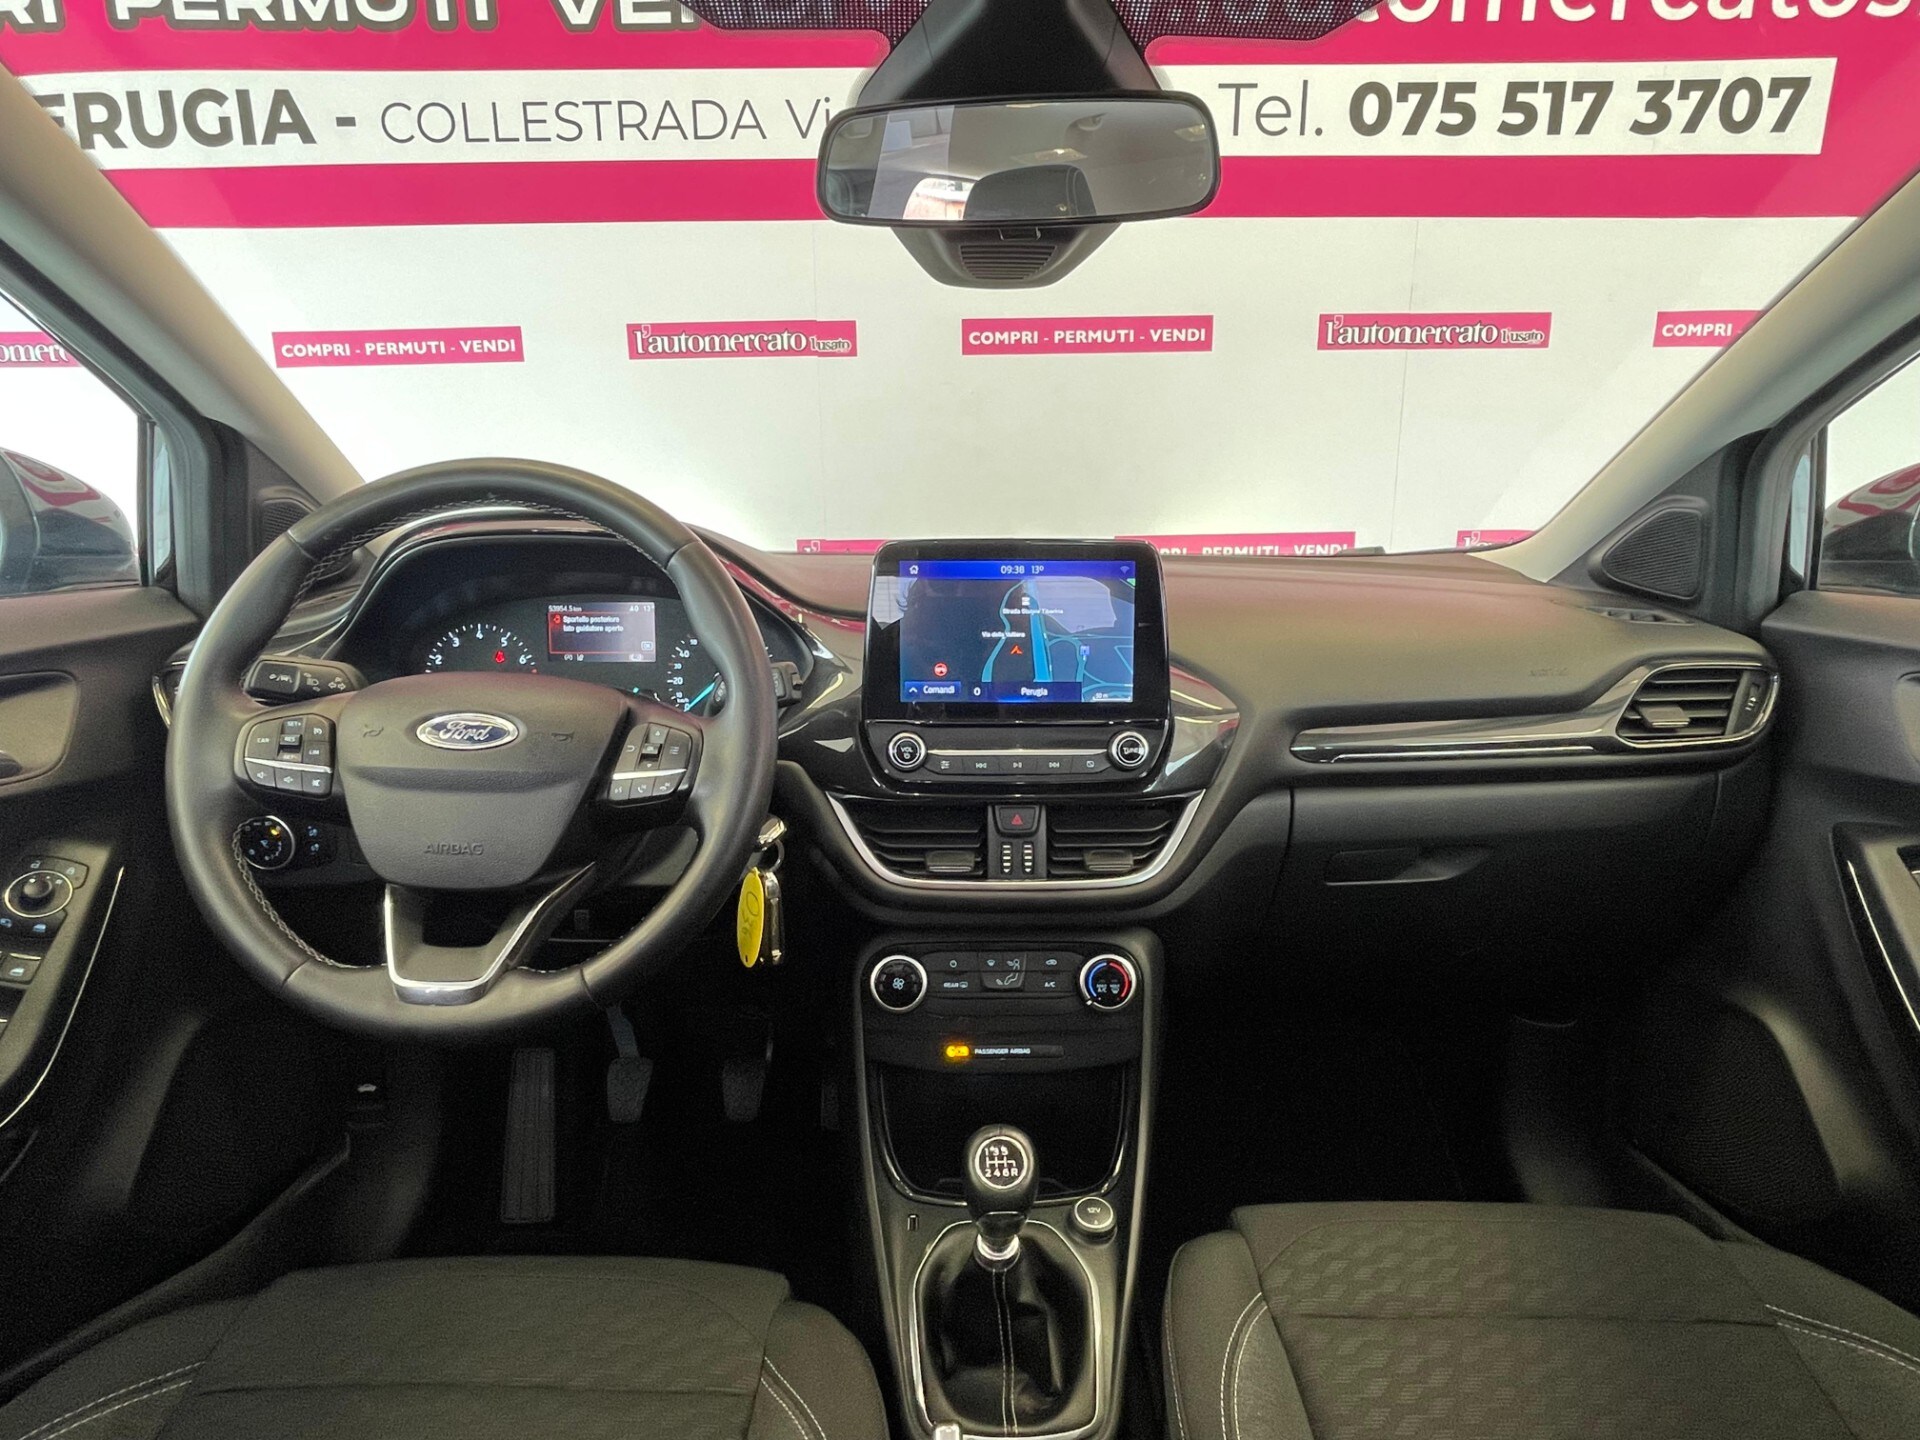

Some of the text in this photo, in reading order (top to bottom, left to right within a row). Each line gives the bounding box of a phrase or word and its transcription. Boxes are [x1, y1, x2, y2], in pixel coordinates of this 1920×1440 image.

[1218, 75, 1813, 139] Tel. 075 517 3707
[380, 98, 768, 146] COLLESTRADA
[1326, 315, 1498, 346] l'automercato
[1661, 321, 1733, 338] COMPRI
[633, 324, 807, 355] l'automercato
[968, 329, 1039, 346] COMPRI
[1053, 327, 1135, 345] PERMUTI
[1149, 326, 1206, 343] VENDI
[281, 342, 351, 358] COMPRI
[365, 340, 446, 356] PERMUTI
[460, 338, 516, 354] VENDI
[1000, 565, 1025, 575] 09:38
[476, 630, 484, 639] 4
[452, 637, 460, 647] 3
[501, 637, 508, 647] 5
[435, 655, 442, 665] 2
[519, 655, 527, 665] 6
[672, 676, 684, 685] 20
[923, 685, 955, 695] Comandi
[1021, 686, 1048, 697] Perugia
[438, 719, 490, 742] Ford
[424, 842, 484, 856] AIRBAG
[985, 1168, 992, 1177] 2
[993, 1168, 1001, 1177] 4
[1010, 1168, 1018, 1177] R
